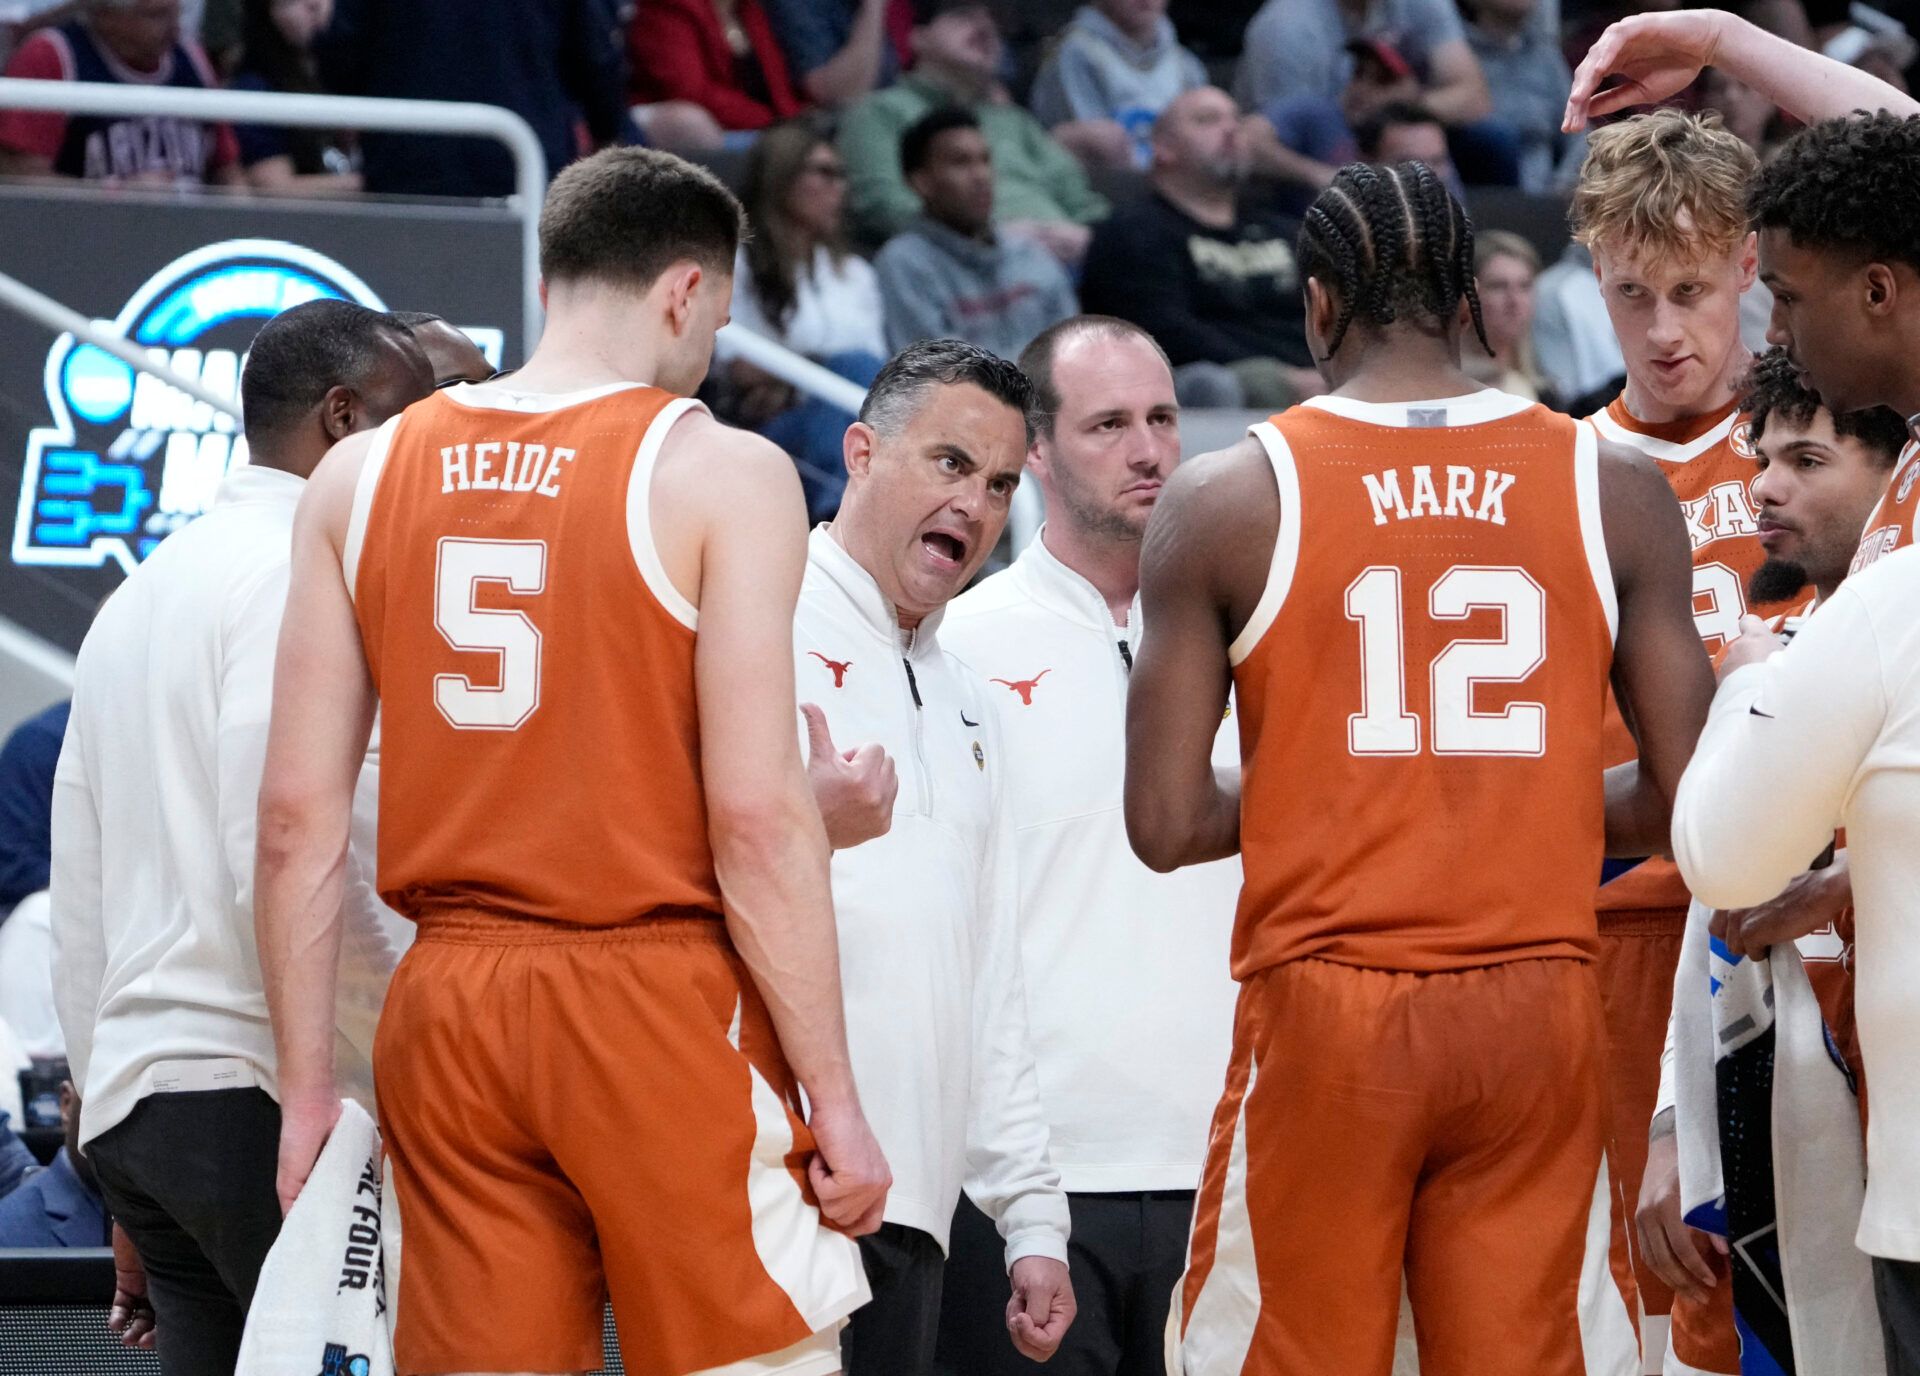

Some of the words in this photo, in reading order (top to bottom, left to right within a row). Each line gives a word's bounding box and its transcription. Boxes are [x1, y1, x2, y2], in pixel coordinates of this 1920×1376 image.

[440, 441, 576, 498] HEIDE
[1361, 465, 1516, 526] MARK
[433, 536, 547, 731] 5
[1344, 565, 1546, 757] 12
